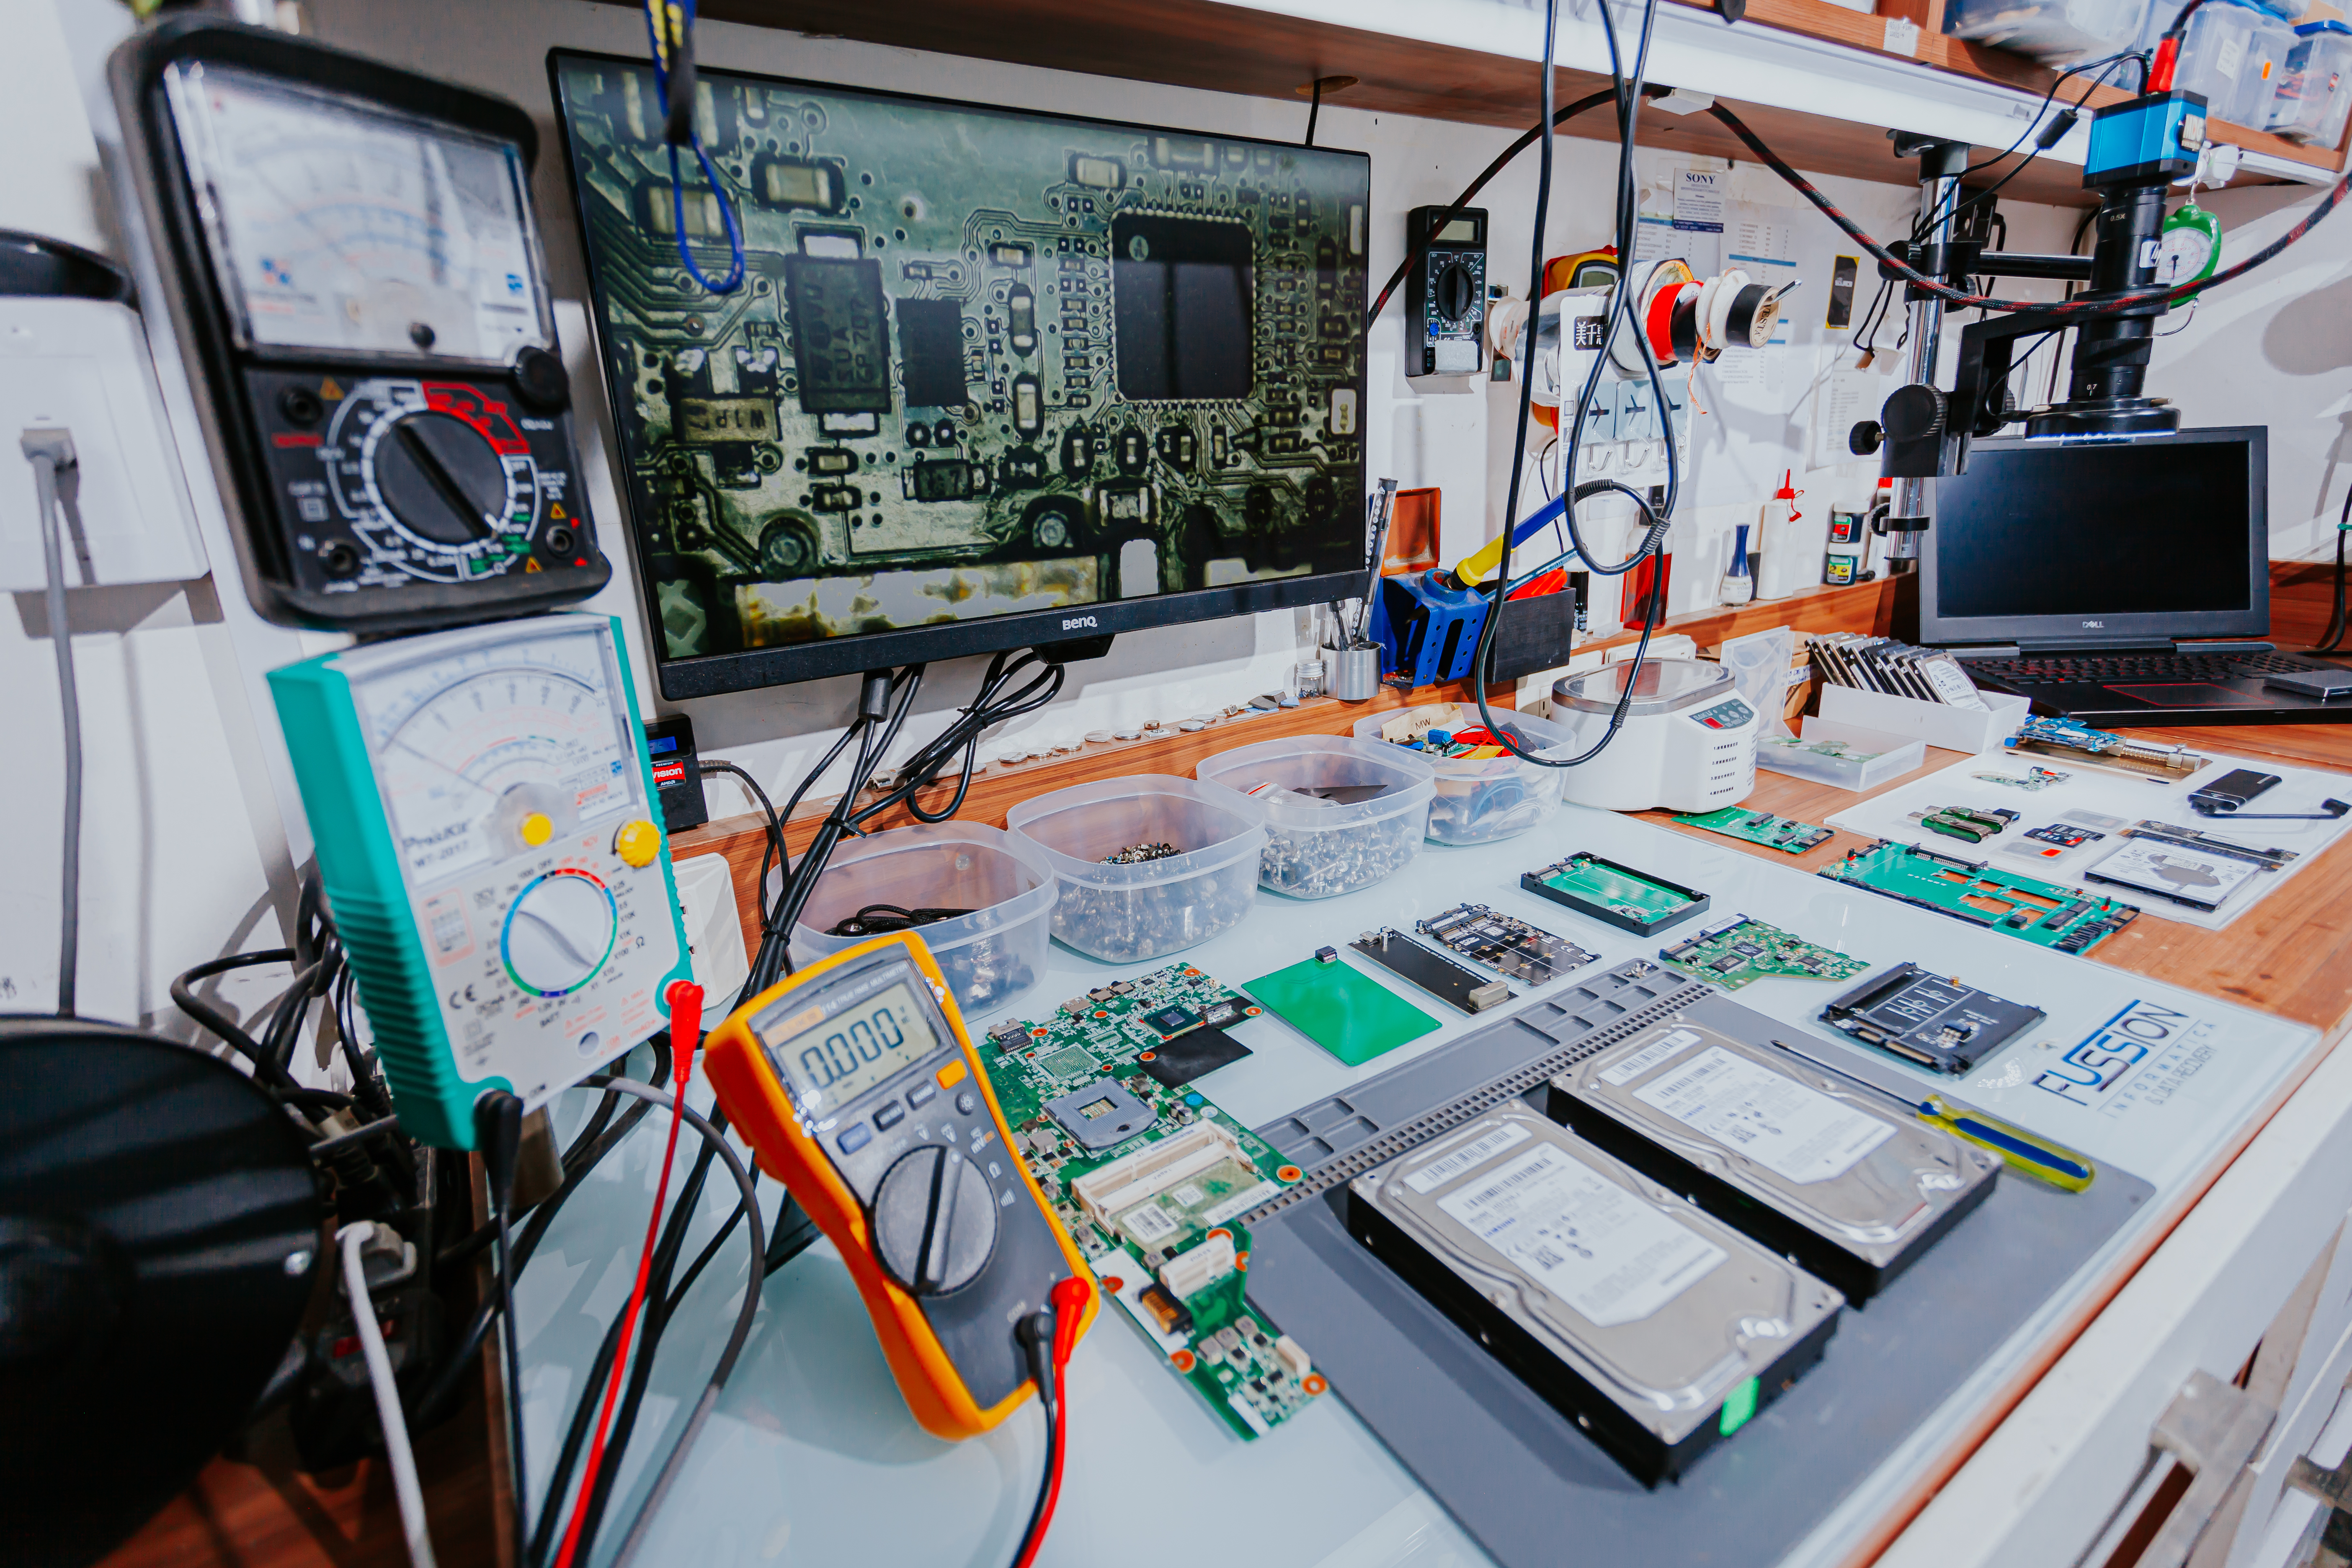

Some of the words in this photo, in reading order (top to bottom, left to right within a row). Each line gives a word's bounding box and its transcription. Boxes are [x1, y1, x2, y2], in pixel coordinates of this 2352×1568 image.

[1686, 173, 1715, 184] SONY
[2110, 213, 2125, 222] 0.5X
[1754, 303, 1772, 336] VESTA
[1063, 616, 1098, 630] BenQ
[1415, 717, 1431, 730] MW
[1693, 710, 1713, 721] BAKU
[1480, 958, 1500, 970] RoHS
[837, 990, 854, 1004] TRUE
[854, 983, 869, 996] RMS
[870, 964, 908, 988] MULTIMETER
[800, 1008, 904, 1089] 0.000
[2028, 999, 2190, 1106] FUSSION
[2102, 1022, 2217, 1119] INFORMATICA
[2152, 1075, 2183, 1100] DATA
[2175, 1044, 2218, 1085] RECOVERY
[1224, 1122, 1269, 1159] Label
[1483, 1217, 1516, 1238] SAMSUNG
